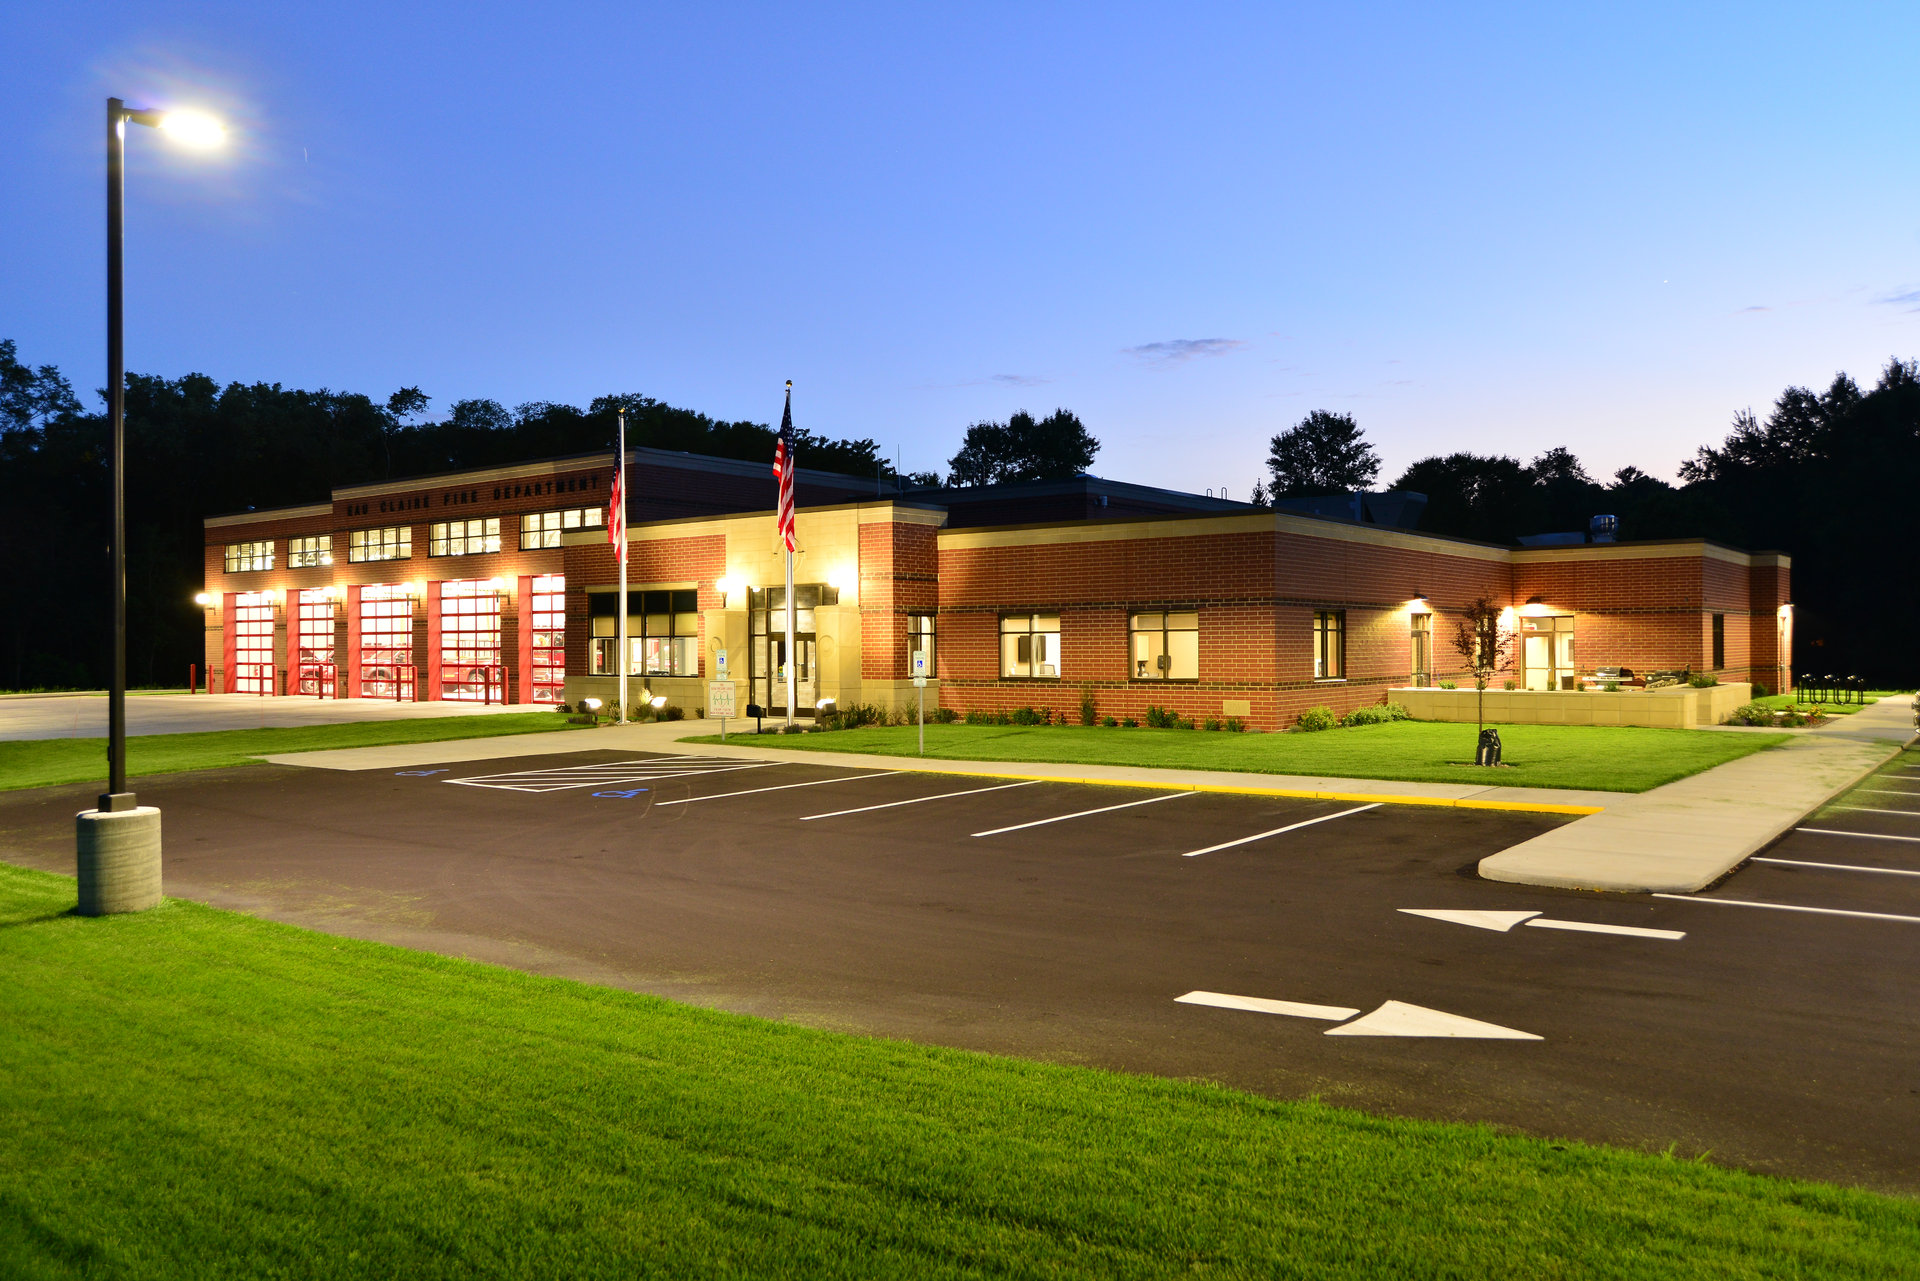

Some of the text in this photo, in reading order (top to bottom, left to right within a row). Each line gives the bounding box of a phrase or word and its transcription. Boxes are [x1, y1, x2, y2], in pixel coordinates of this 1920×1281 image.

[347, 477, 597, 516] EAU CLAIRE FIRE DEPARTMENT
